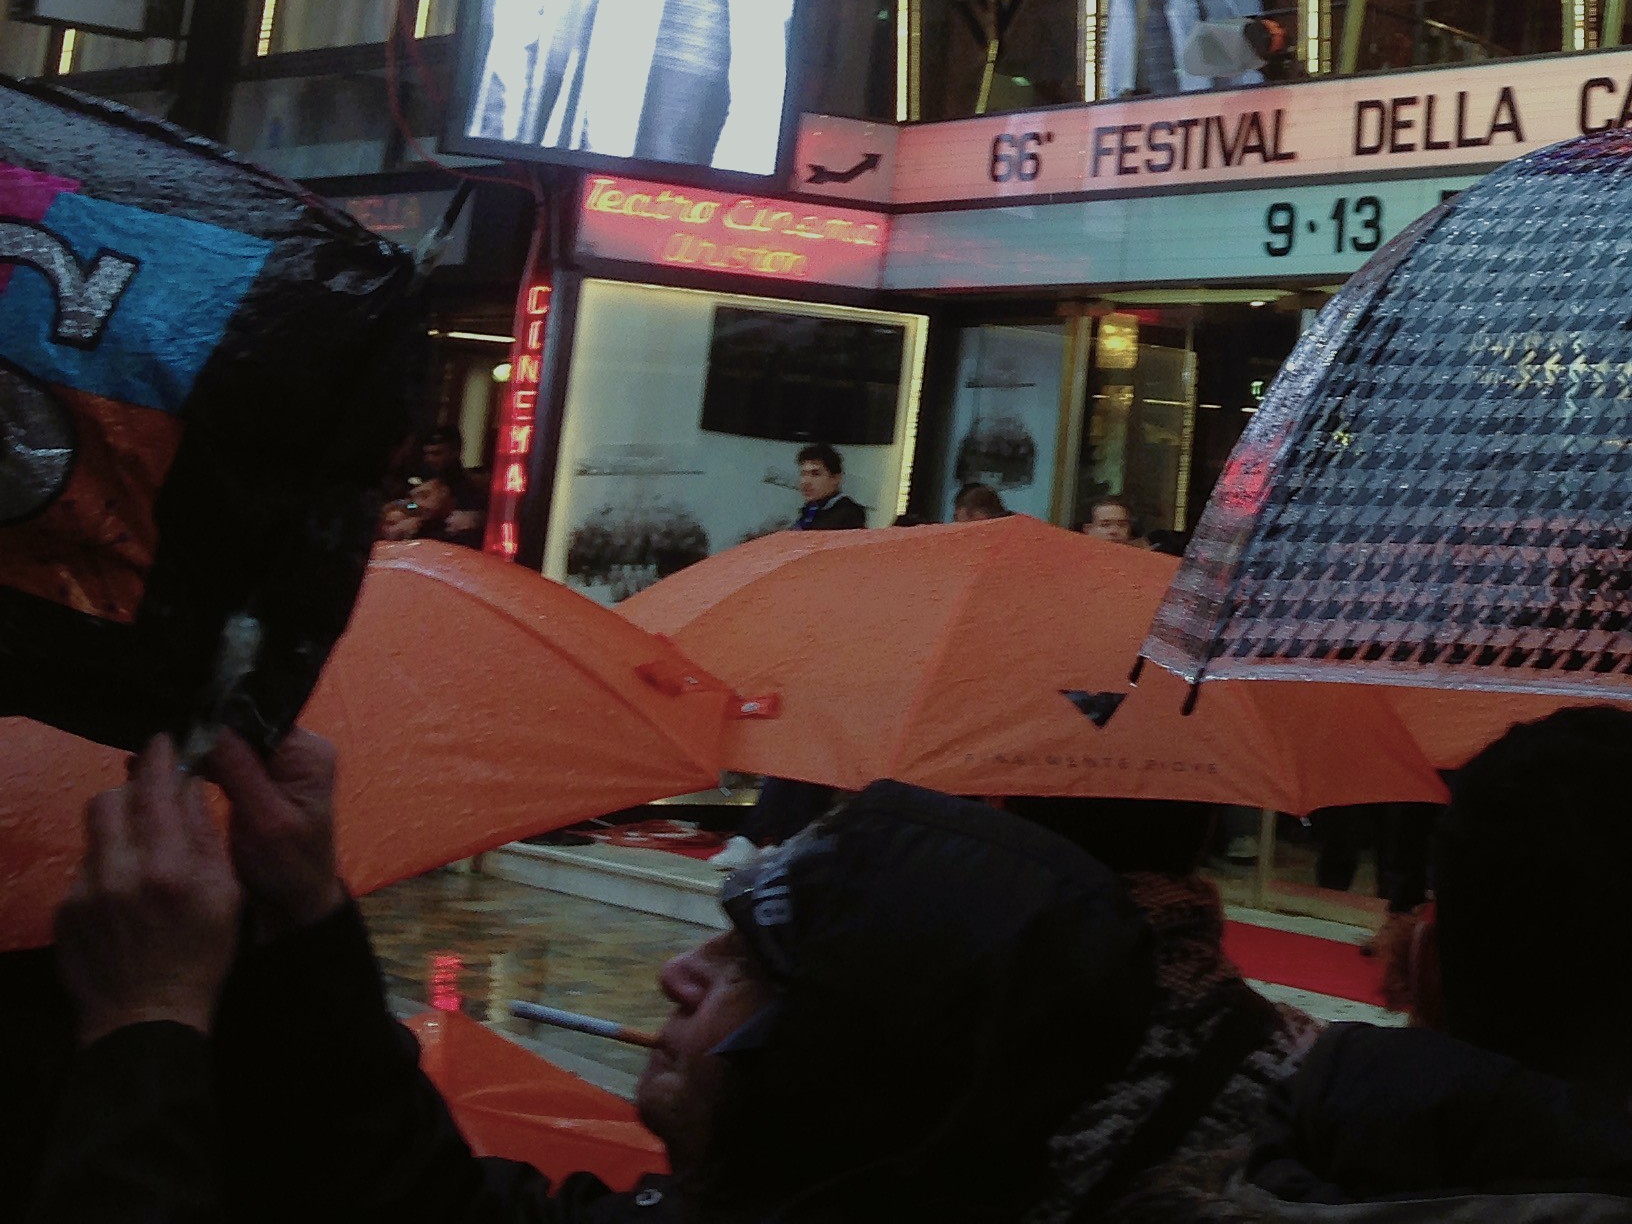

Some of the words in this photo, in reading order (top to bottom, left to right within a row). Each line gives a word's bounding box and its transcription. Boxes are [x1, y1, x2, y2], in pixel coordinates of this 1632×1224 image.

[1089, 108, 1299, 179] FESTIVAL
[1352, 87, 1525, 157] DELLA
[584, 178, 721, 225] Teatro
[504, 284, 553, 494] CINEMA
